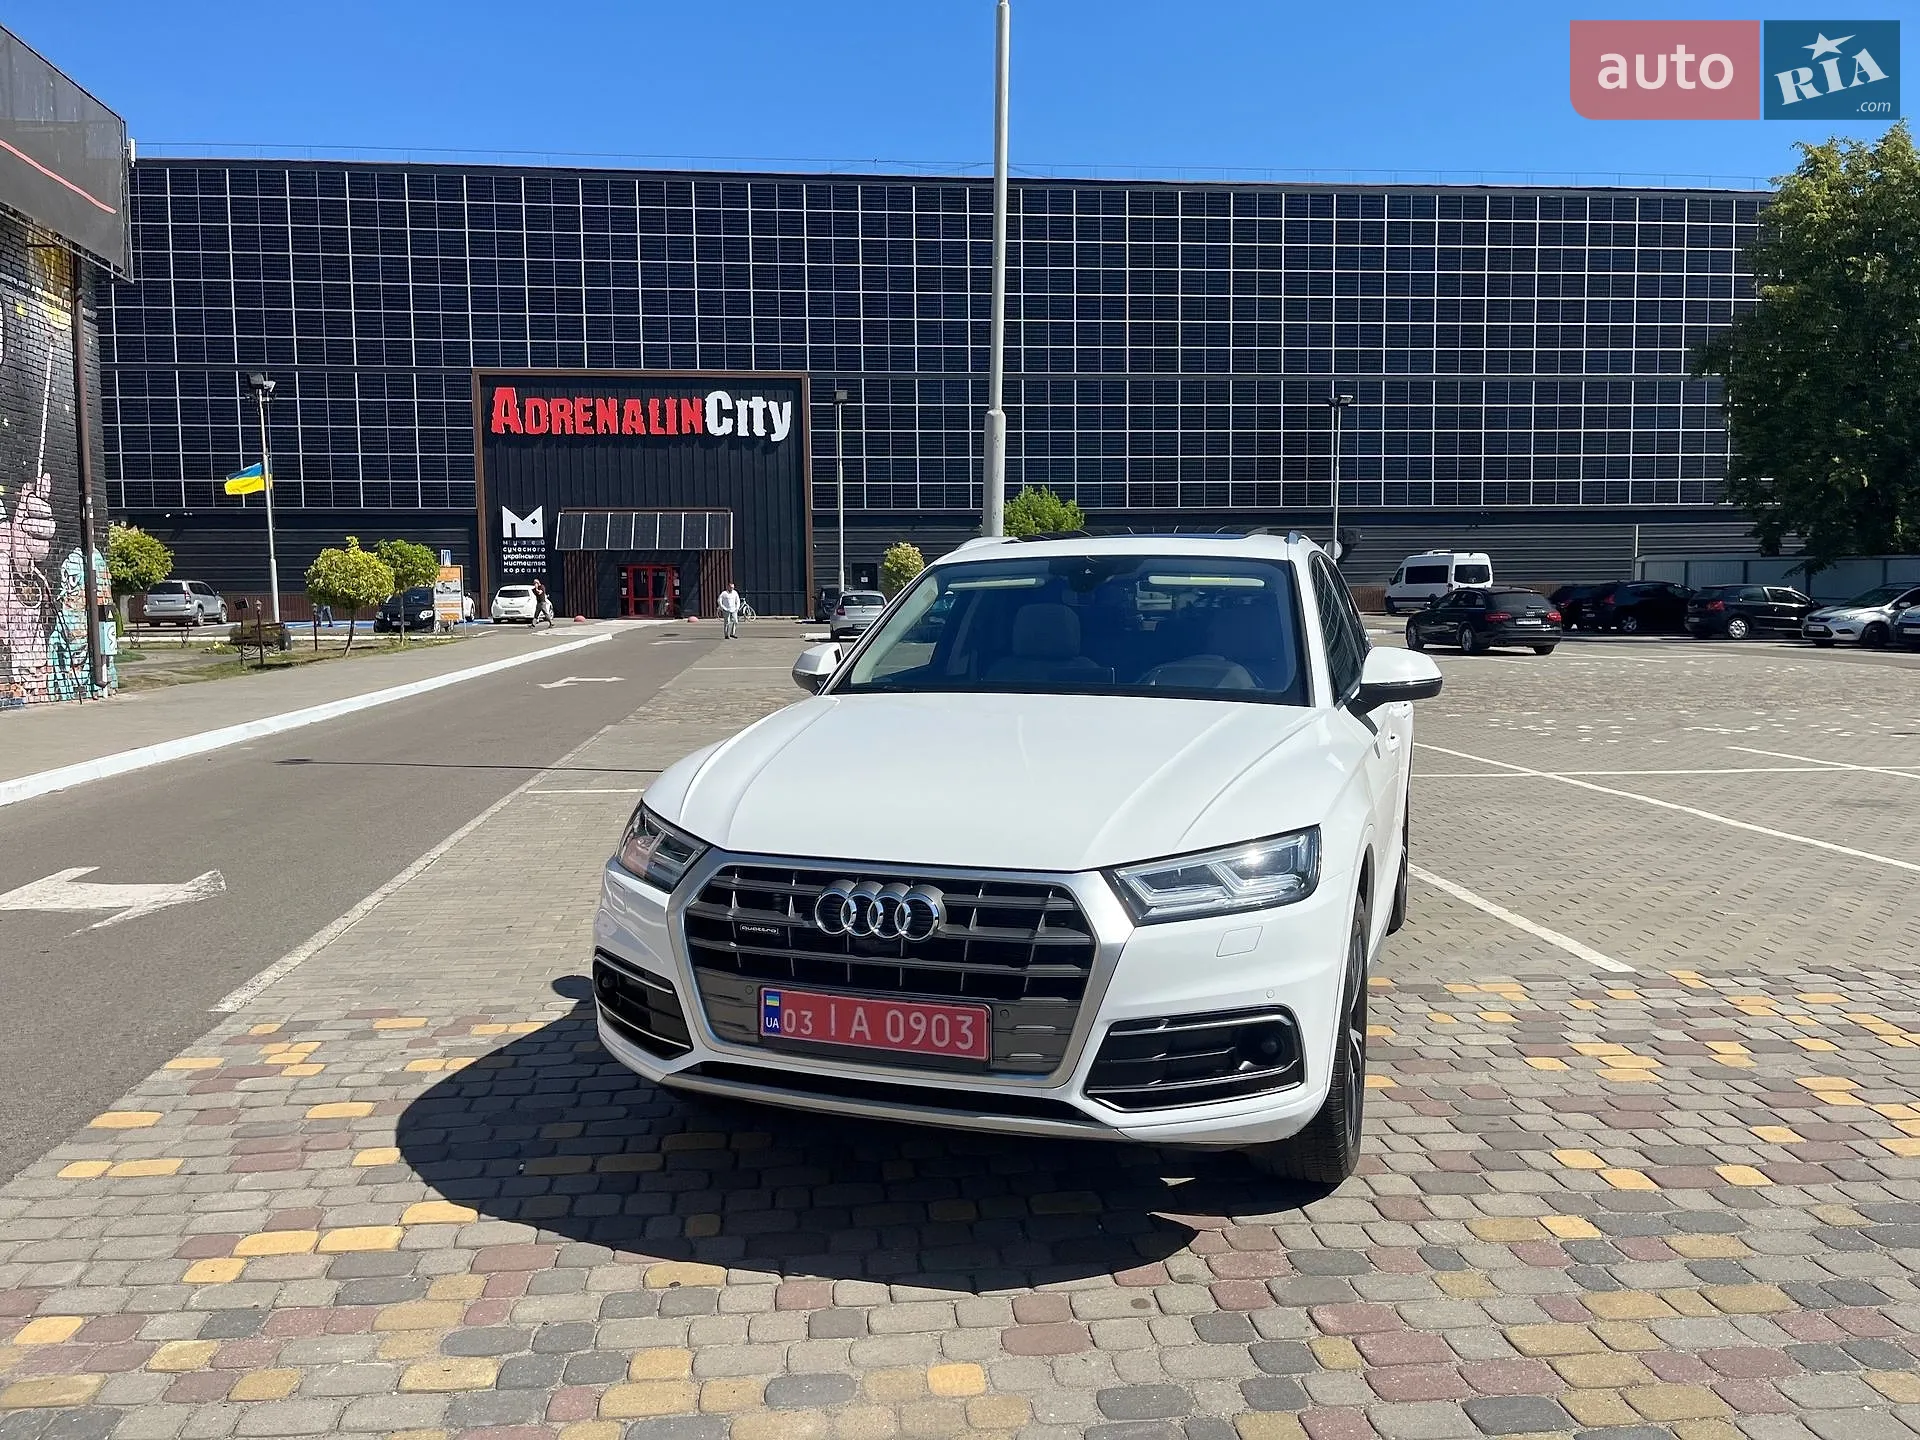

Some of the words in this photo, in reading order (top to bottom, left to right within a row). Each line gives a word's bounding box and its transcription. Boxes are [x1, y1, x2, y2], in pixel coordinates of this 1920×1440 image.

[765, 1017, 779, 1029] UA
[783, 1009, 812, 1034] 03
[886, 1009, 973, 1050] 0903
